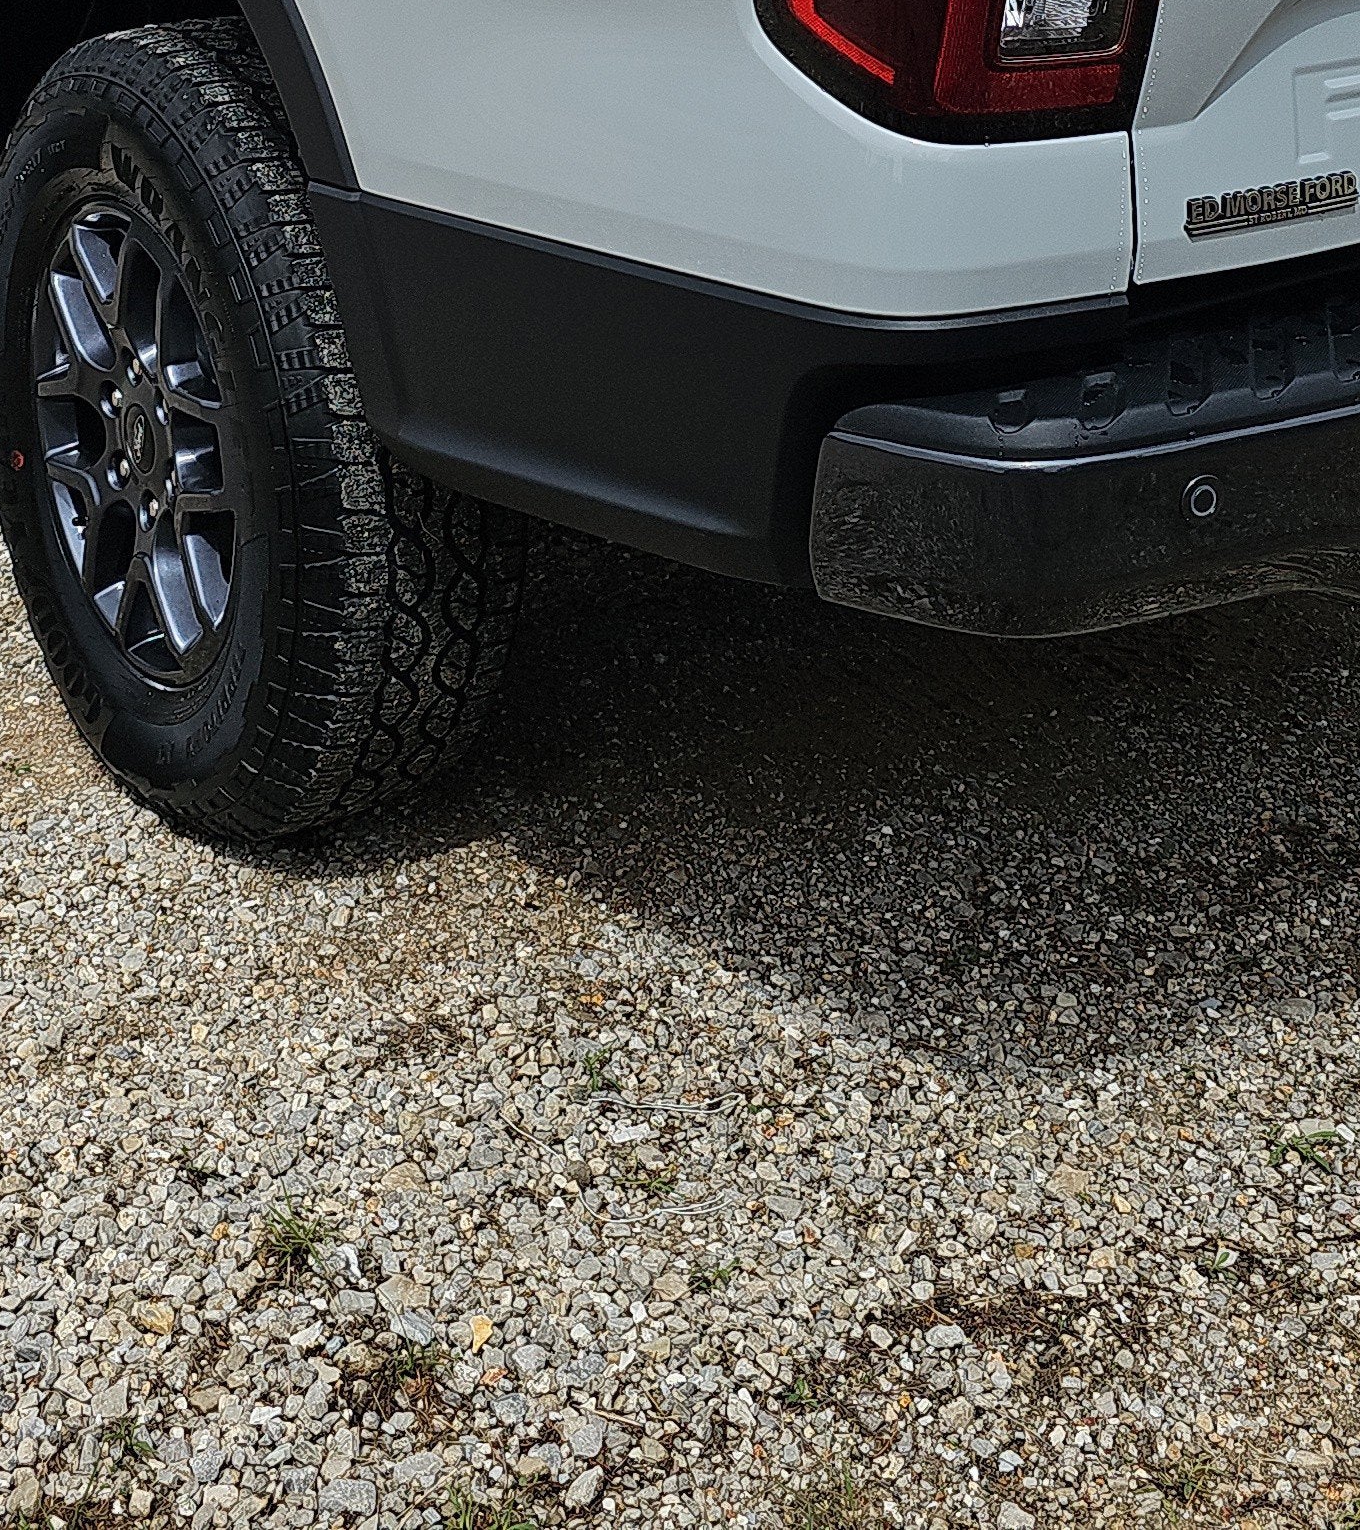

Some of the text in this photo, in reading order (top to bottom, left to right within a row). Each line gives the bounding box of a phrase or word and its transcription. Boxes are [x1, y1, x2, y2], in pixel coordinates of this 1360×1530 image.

[1187, 170, 1357, 223] ED MORSE FORD
